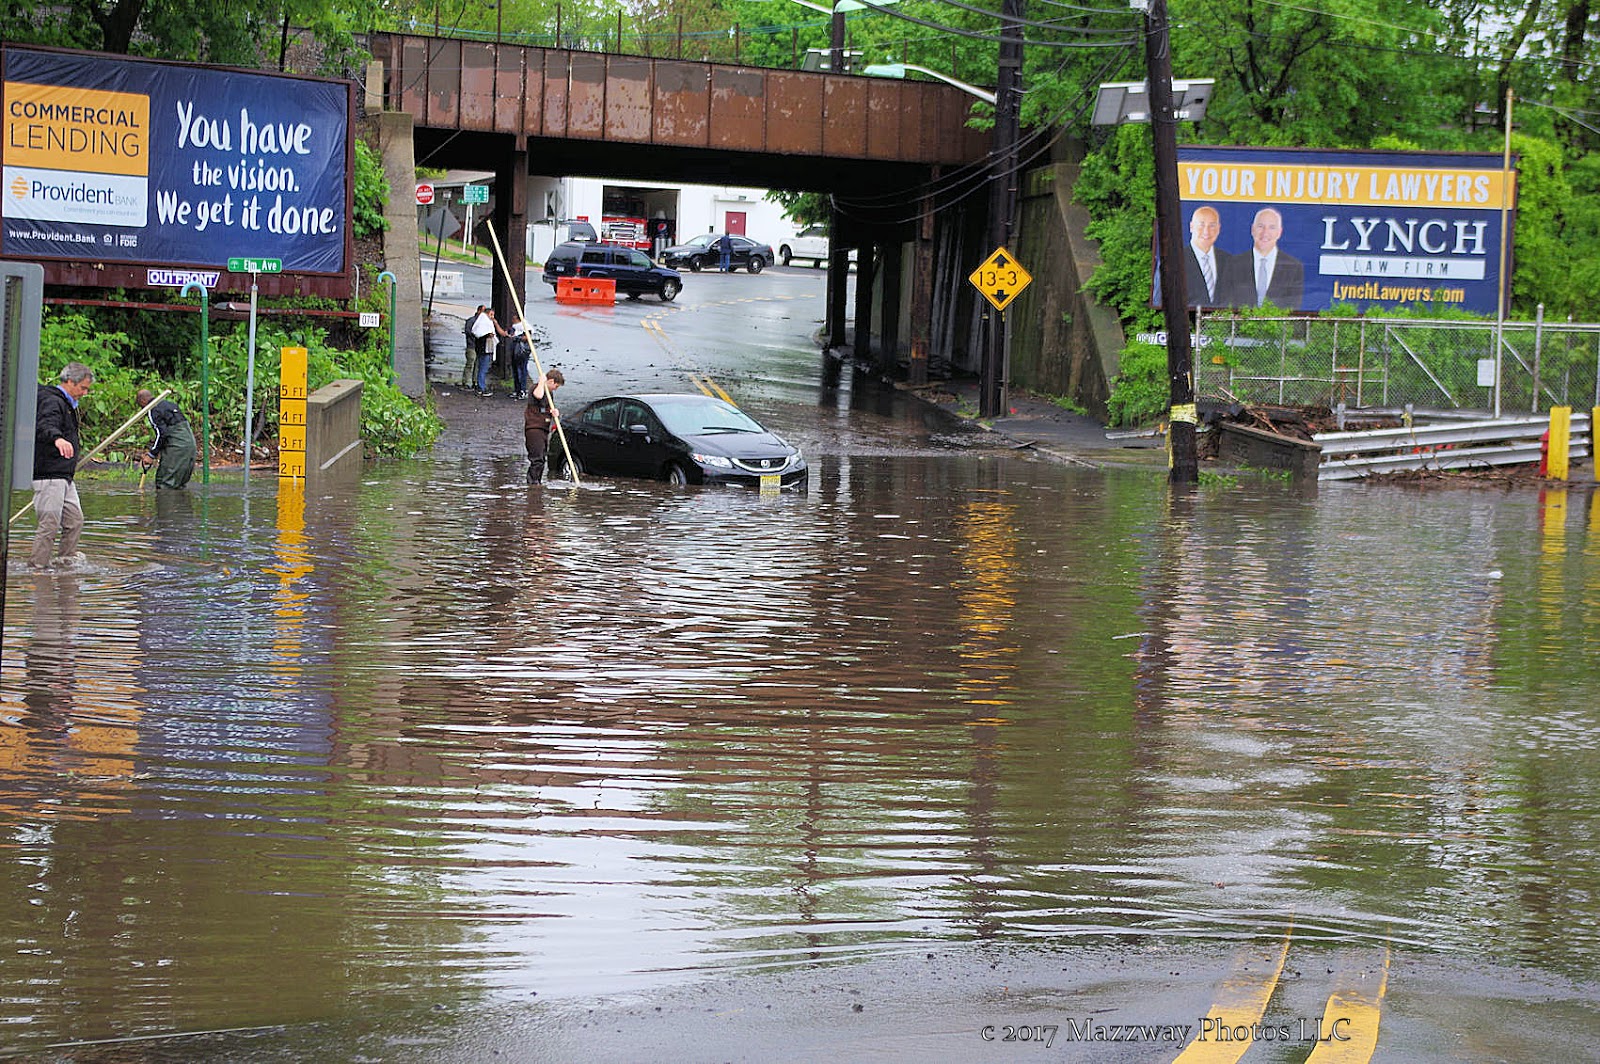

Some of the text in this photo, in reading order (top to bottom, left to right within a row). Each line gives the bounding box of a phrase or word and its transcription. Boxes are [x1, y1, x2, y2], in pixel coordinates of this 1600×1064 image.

[10, 100, 140, 128] COMMERCIAL
[176, 100, 312, 154] You have
[10, 122, 140, 157] LENDING
[192, 158, 300, 192] the vision.
[31, 180, 138, 206] Provident BANK
[1186, 167, 1491, 204] YOUR INJURY LAWYERS
[156, 189, 337, 235] We get it done.
[9, 230, 96, 244] www.Provident.Bank
[120, 239, 138, 247] FDIC
[1319, 216, 1487, 254] LYNCH
[243, 259, 277, 271] Elm Ave
[1353, 259, 1450, 275] LAW FIRM
[150, 271, 216, 287] OUTFRONT
[281, 385, 288, 397] 5
[281, 411, 288, 423] 4
[280, 437, 288, 449] 3
[280, 463, 287, 475] 2
